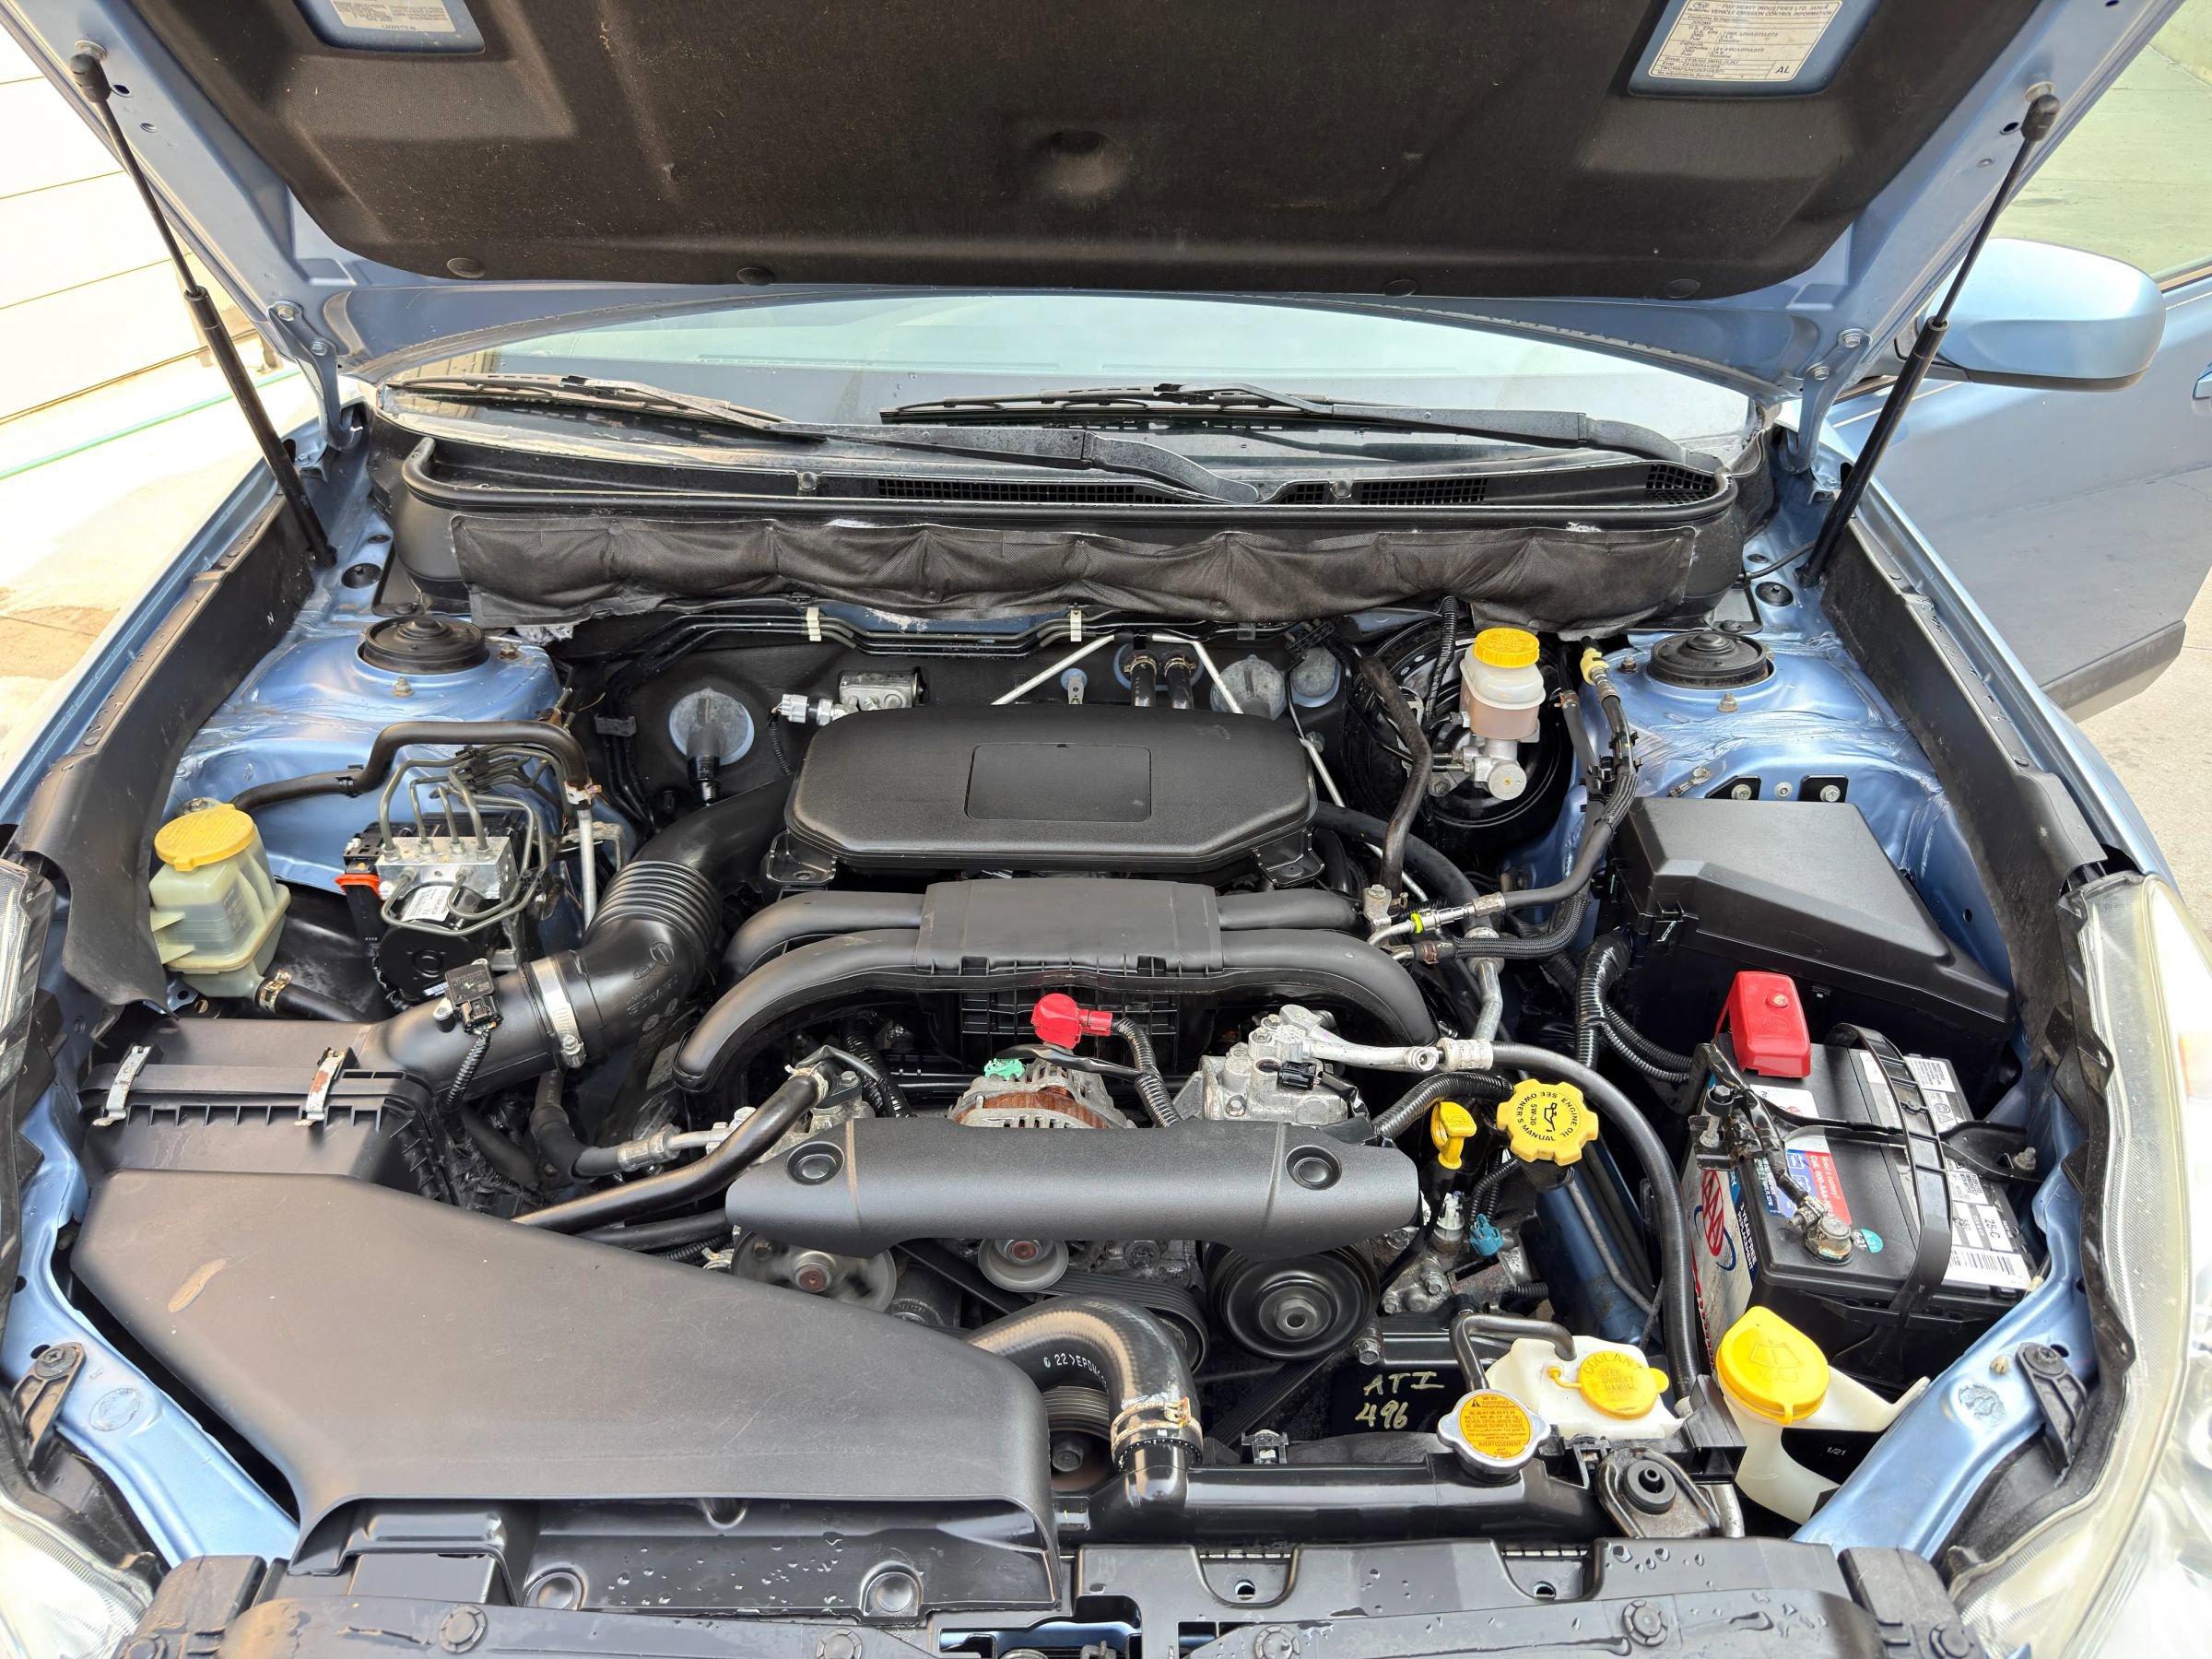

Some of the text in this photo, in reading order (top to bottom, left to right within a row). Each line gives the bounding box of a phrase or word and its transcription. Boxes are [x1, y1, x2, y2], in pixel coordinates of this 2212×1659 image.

[1775, 65, 1790, 74] AL
[1560, 1098, 1578, 1137] ENGINE OIL
[1522, 1124, 1556, 1142] MANUAL
[1736, 1210, 1755, 1270] REPLACEMENT
[1741, 1209, 1752, 1236] YEAR
[1747, 1236, 1758, 1263] FREE
[1983, 1218, 2001, 1239] 25-C
[1583, 1352, 1643, 1374] COOLANT
[1363, 1371, 1445, 1395] ATI
[1354, 1399, 1408, 1430] 496
[1827, 1446, 1847, 1456] 1/21
